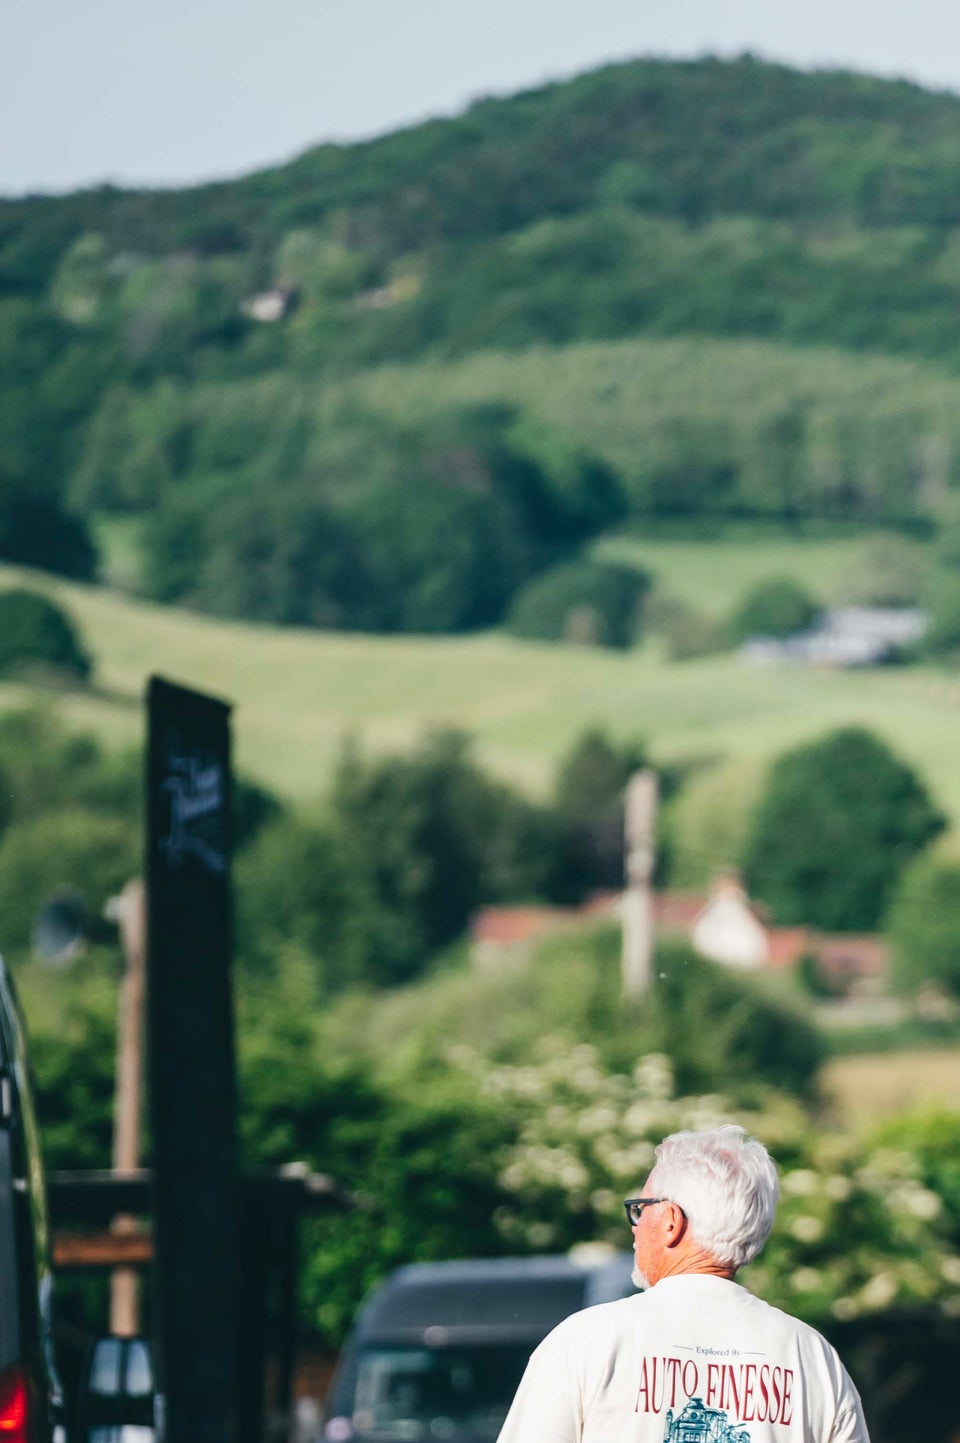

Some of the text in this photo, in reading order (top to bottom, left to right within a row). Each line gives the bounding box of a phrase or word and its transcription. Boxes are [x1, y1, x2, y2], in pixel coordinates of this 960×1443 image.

[696, 1346, 741, 1358] Explored By
[635, 1356, 793, 1426] AUTO FINESSE
